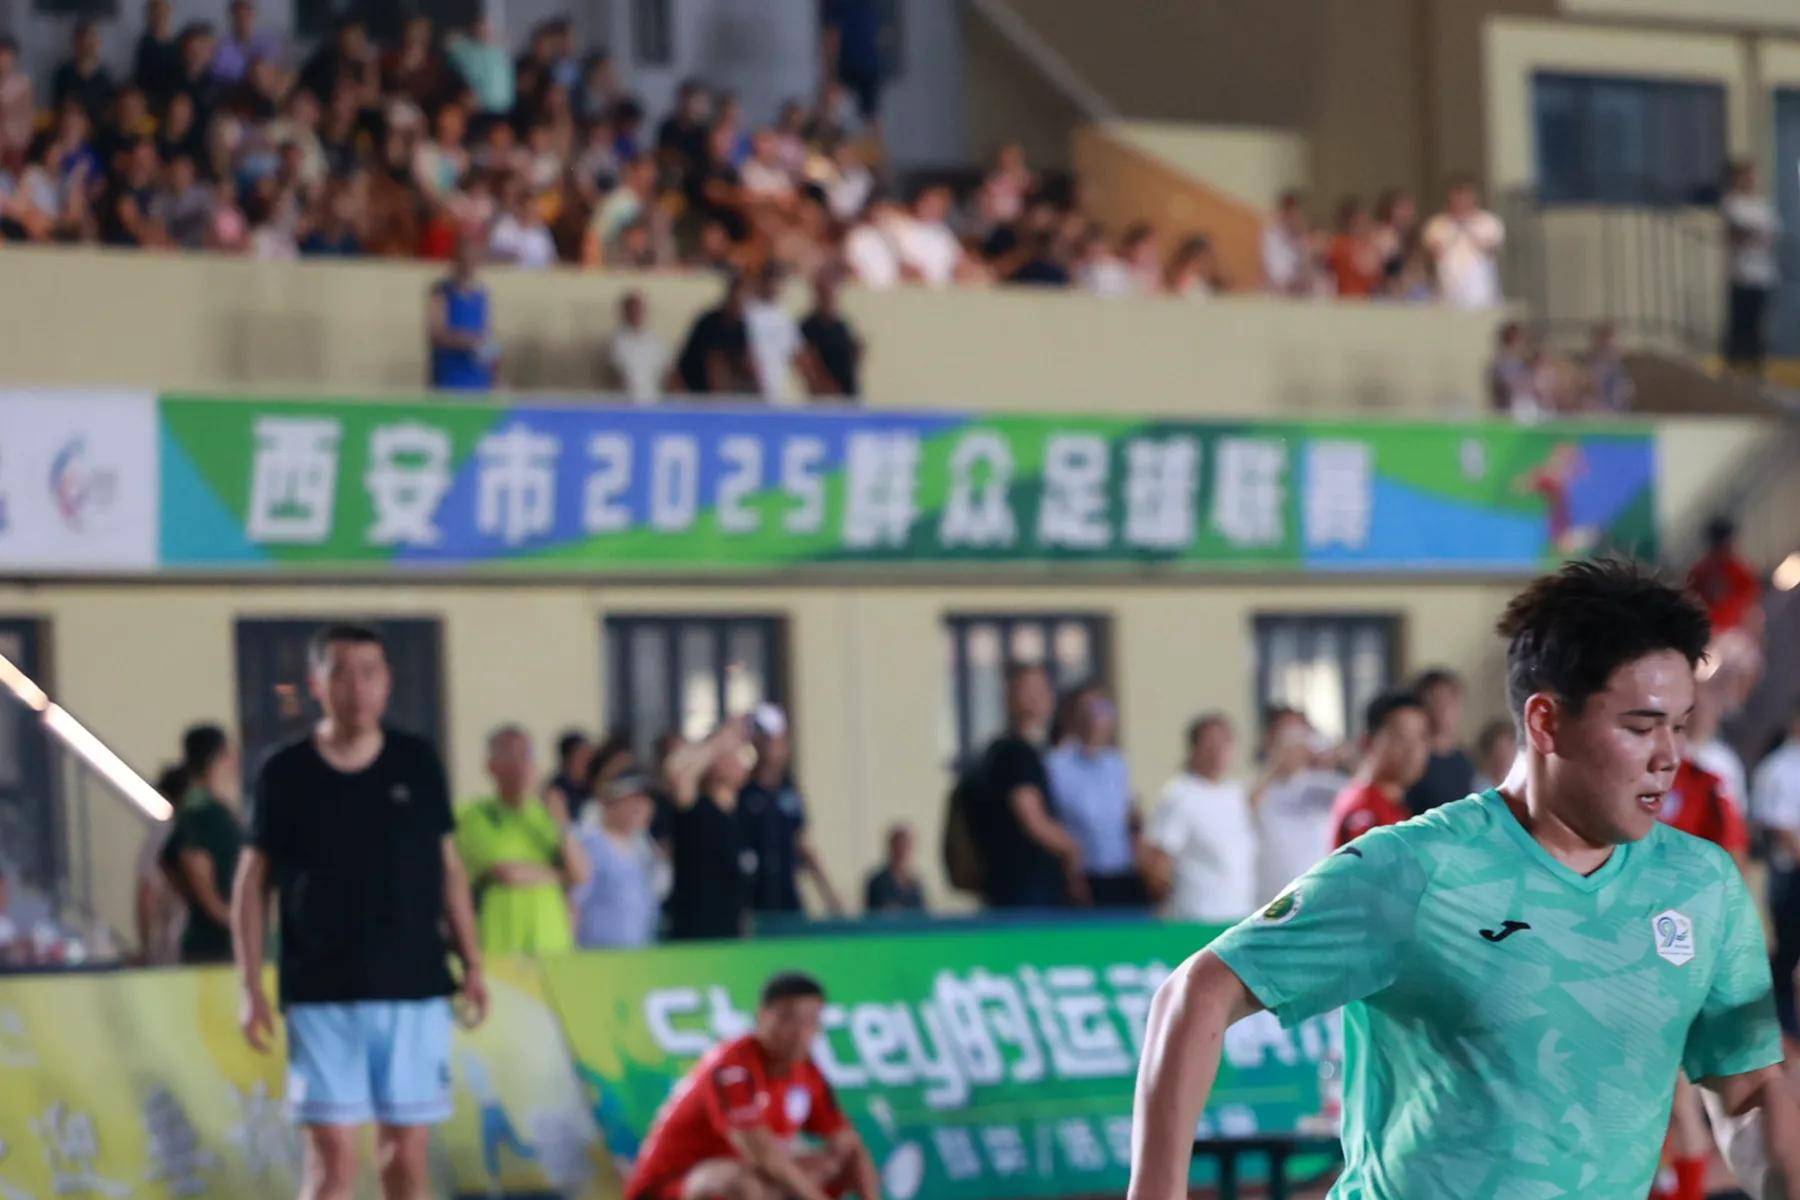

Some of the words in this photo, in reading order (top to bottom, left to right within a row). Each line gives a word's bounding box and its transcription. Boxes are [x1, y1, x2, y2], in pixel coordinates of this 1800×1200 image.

[246, 415, 1372, 548] 西安市2025群众足球联赛
